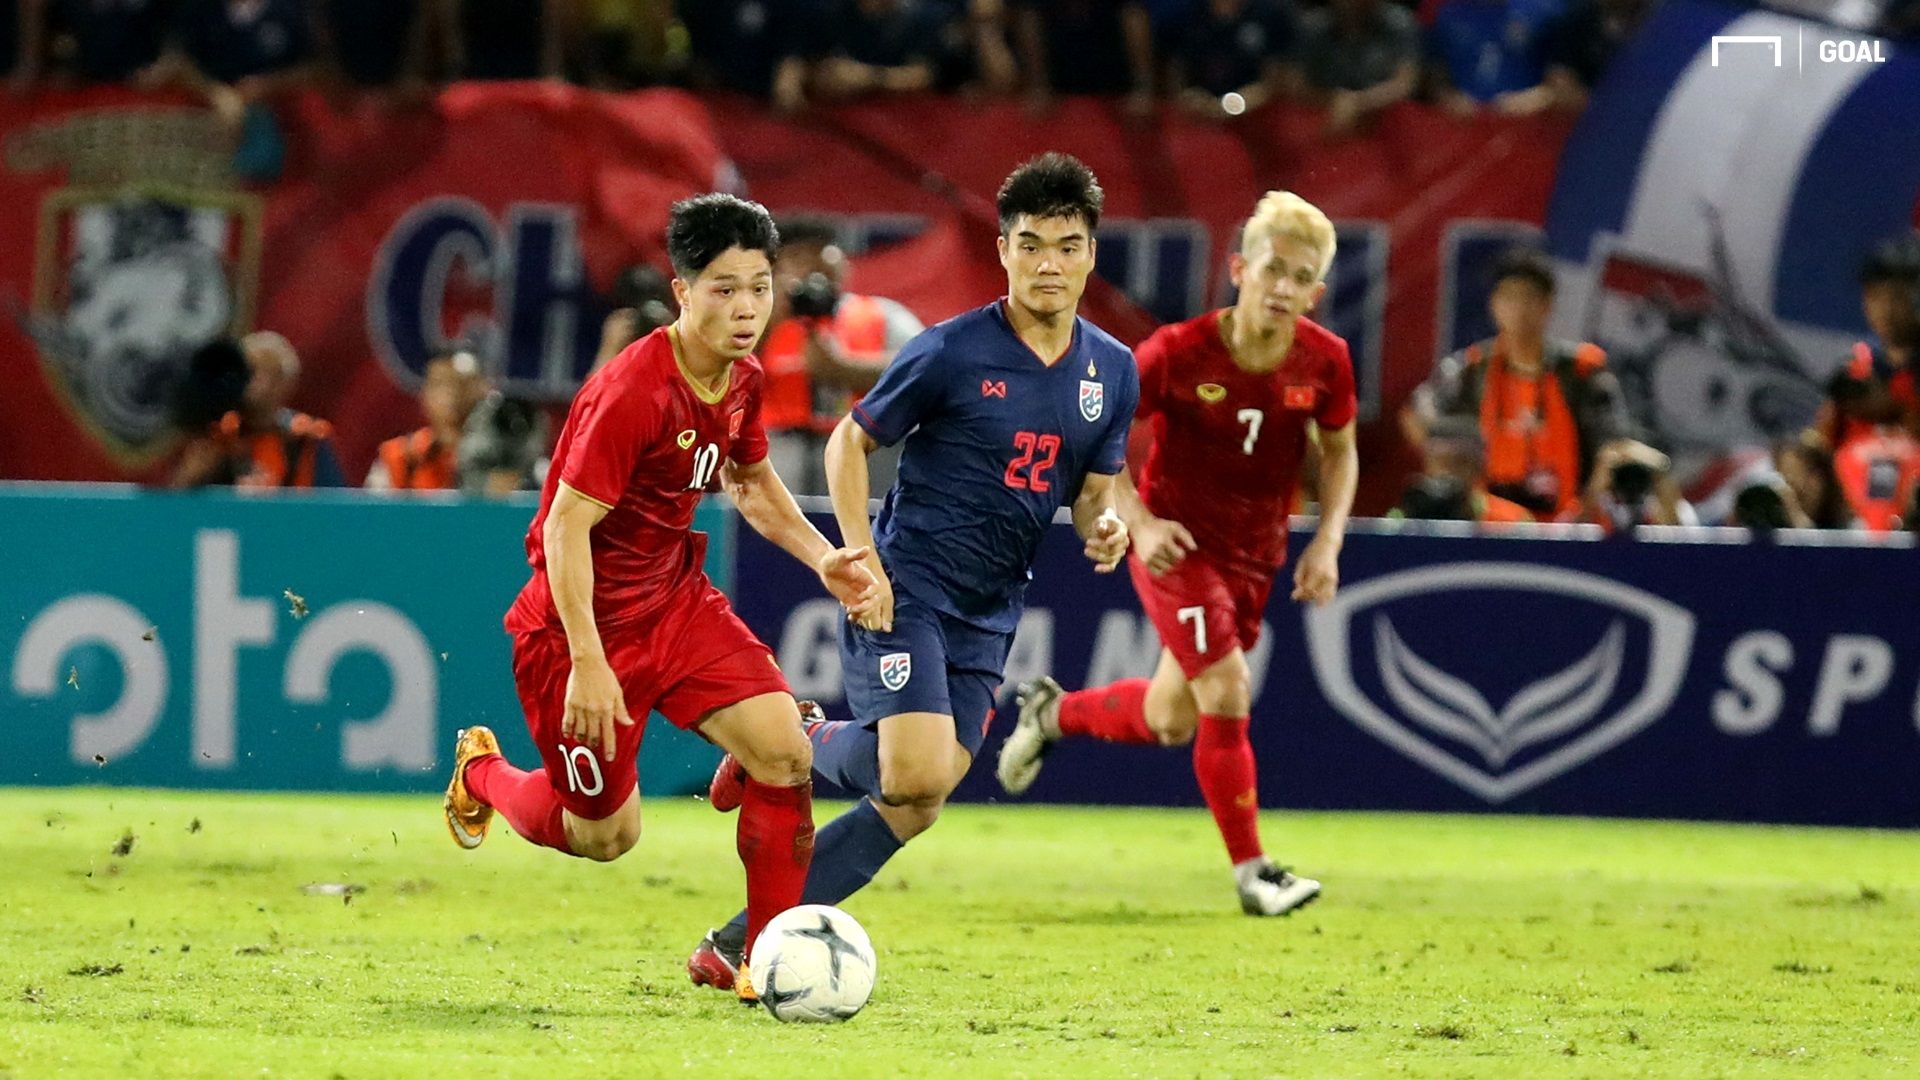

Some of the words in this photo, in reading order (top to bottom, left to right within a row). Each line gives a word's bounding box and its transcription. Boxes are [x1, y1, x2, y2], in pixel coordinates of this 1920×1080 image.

[1237, 408, 1264, 455] 7
[683, 442, 719, 492] 10
[1004, 431, 1061, 492] 22
[1176, 605, 1207, 654] 7
[1709, 629, 1920, 738] SP
[558, 744, 604, 796] 10
